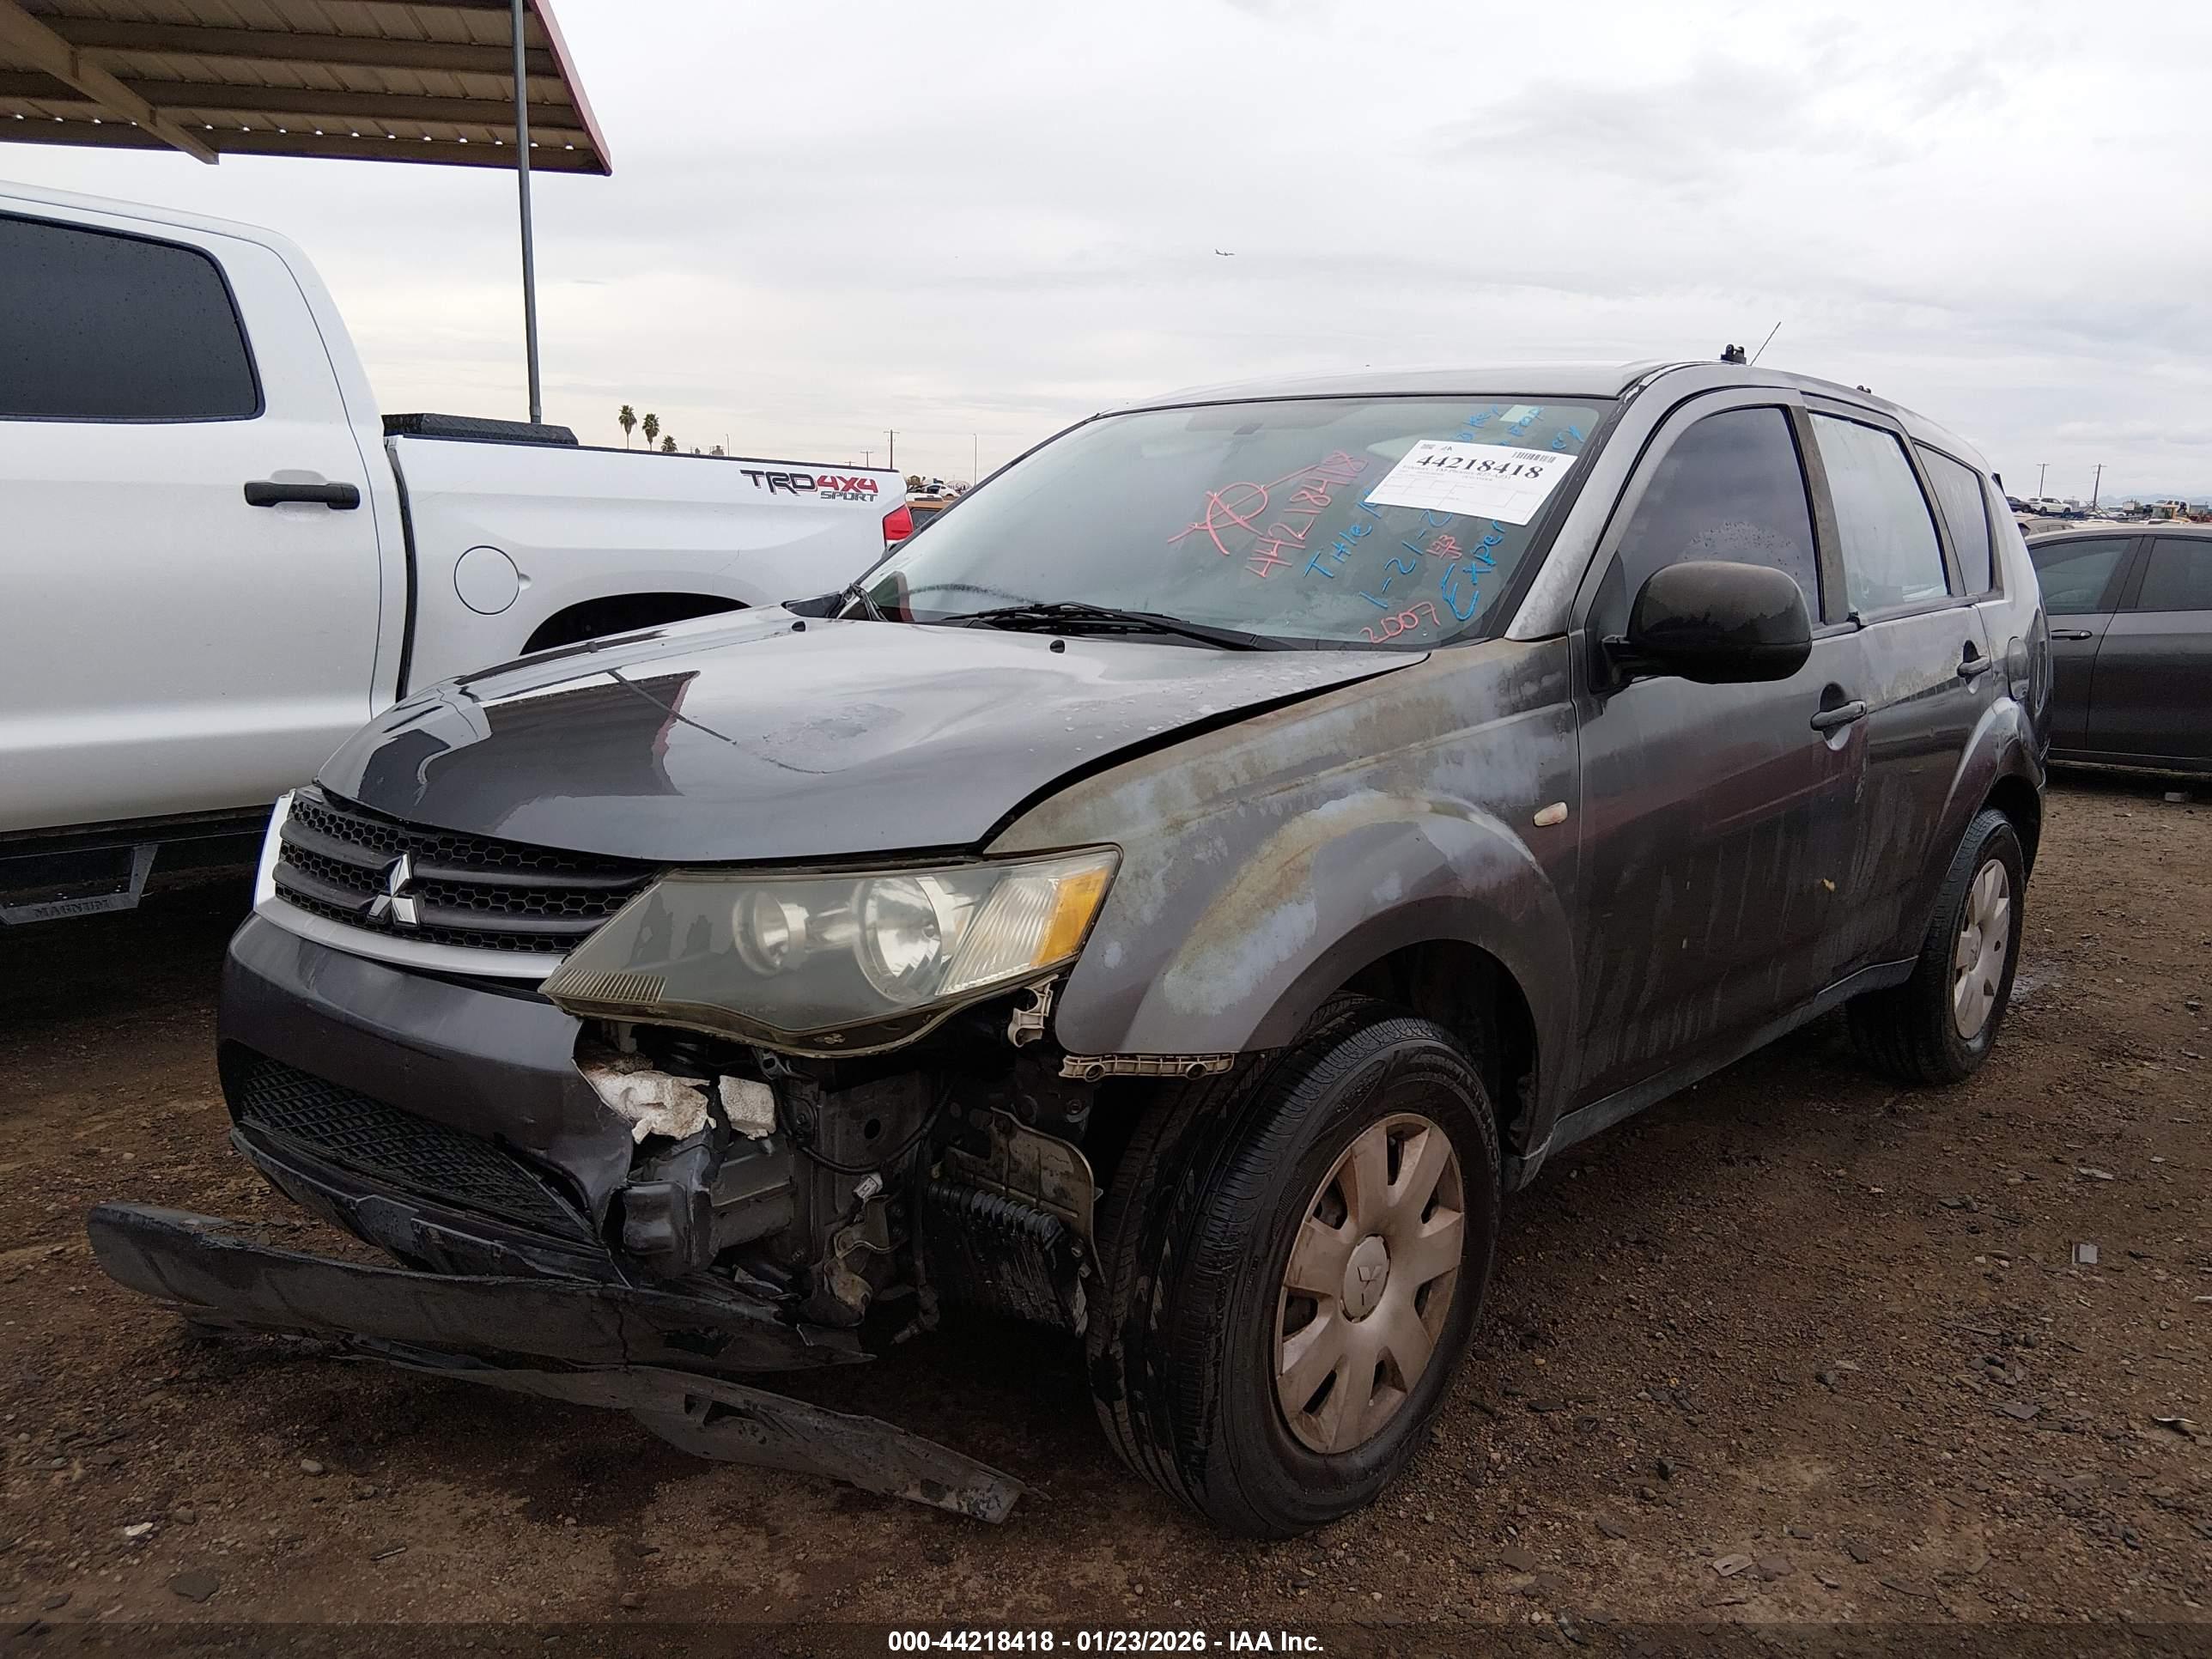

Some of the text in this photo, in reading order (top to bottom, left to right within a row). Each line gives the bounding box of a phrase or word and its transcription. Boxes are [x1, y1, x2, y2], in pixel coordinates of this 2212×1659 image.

[1417, 454, 1544, 479] 44218418
[739, 469, 817, 496] TRD
[820, 490, 878, 502] SPORT
[1359, 509, 1453, 609] 1-21-2
[1440, 520, 1505, 621] Exper
